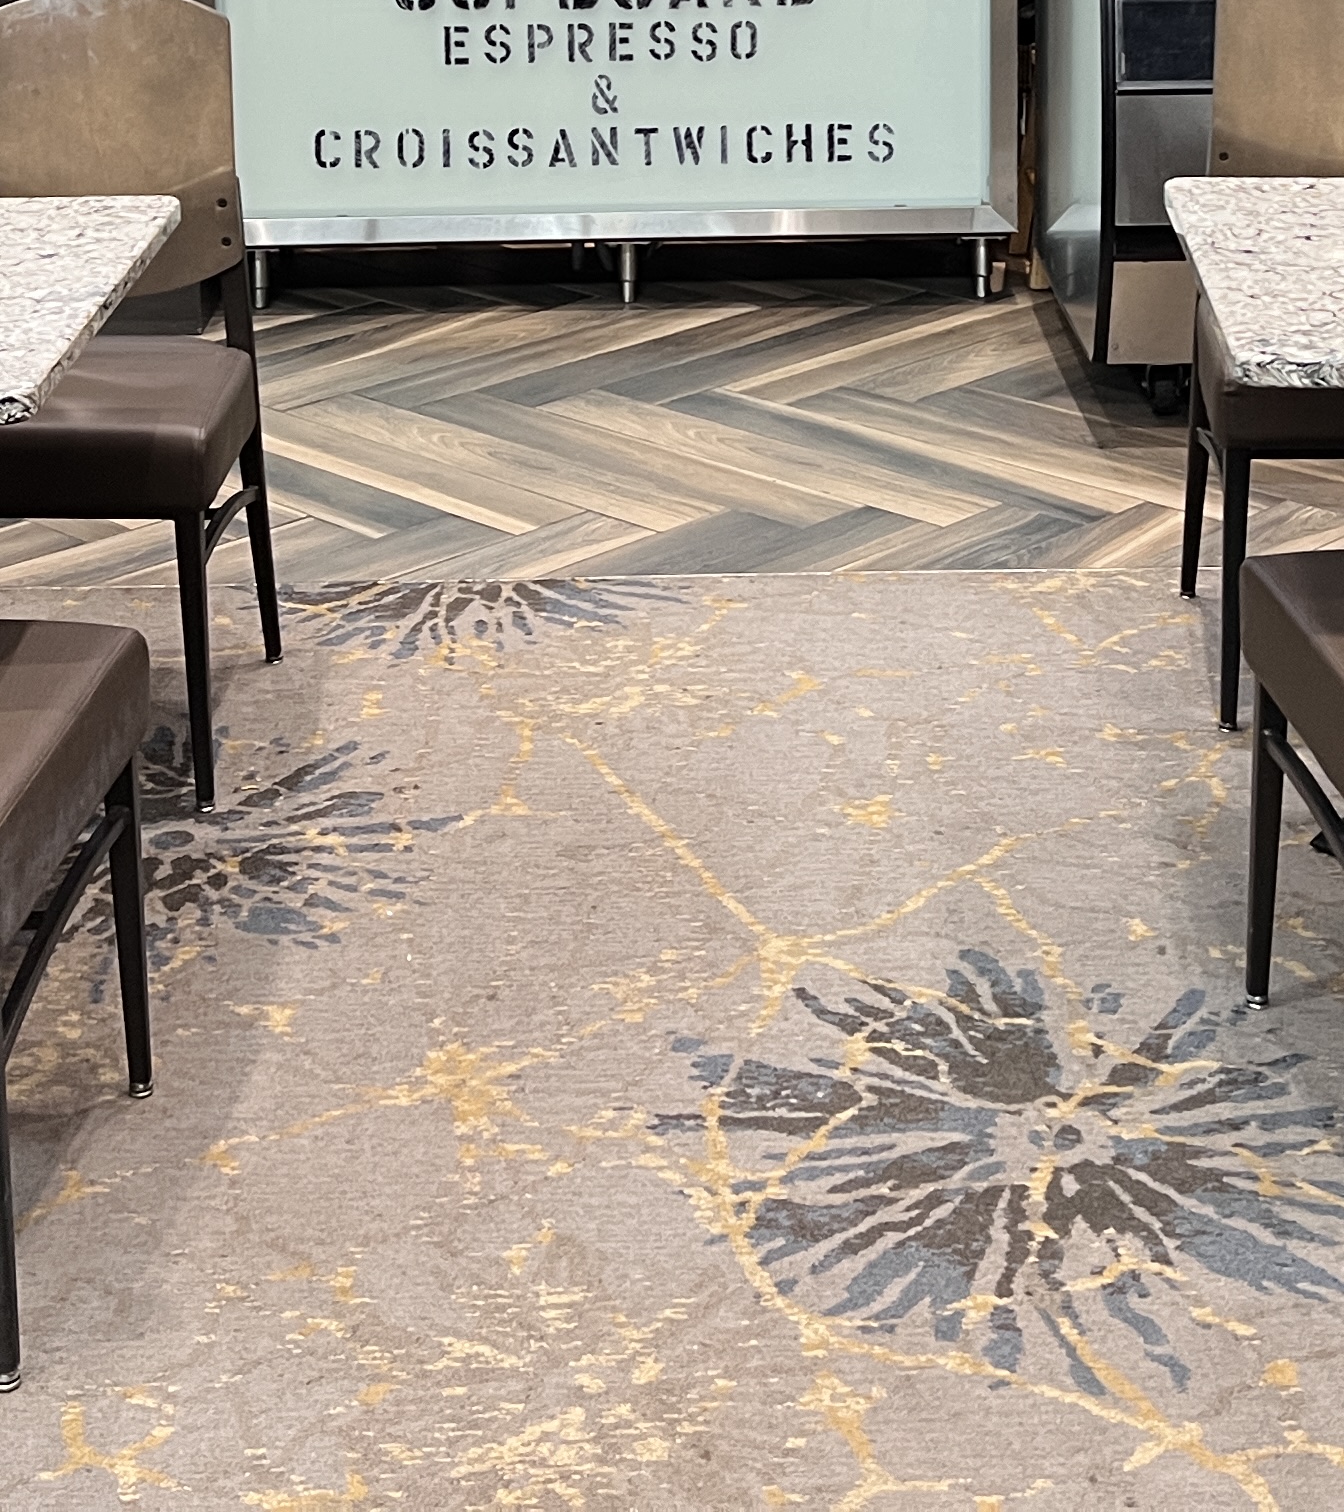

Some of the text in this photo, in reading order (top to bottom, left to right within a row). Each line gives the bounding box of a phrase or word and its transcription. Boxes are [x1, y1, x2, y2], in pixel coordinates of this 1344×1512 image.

[444, 20, 758, 65] ESPRESSO
[591, 74, 618, 115] &
[314, 122, 896, 169] CROISSANTWICHES
